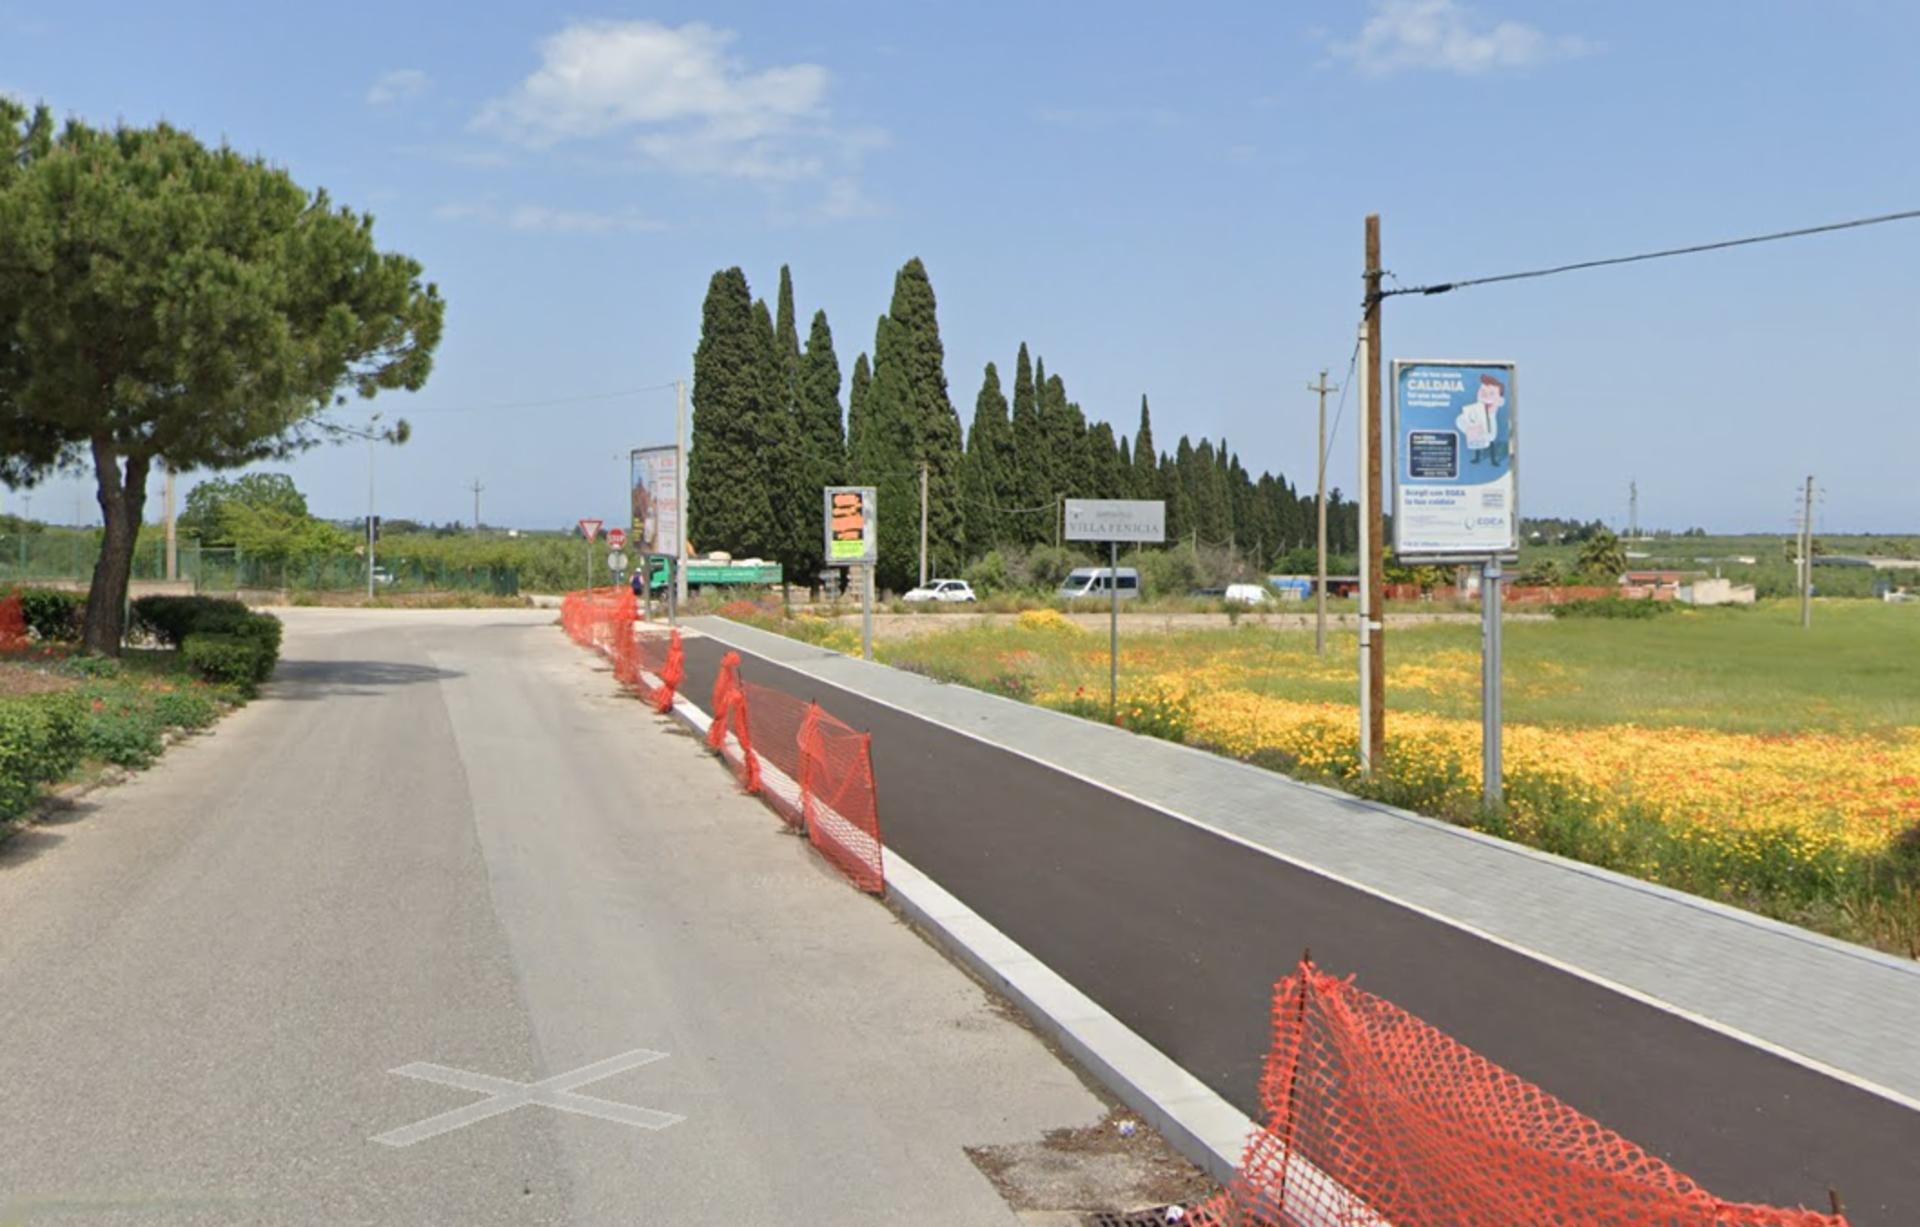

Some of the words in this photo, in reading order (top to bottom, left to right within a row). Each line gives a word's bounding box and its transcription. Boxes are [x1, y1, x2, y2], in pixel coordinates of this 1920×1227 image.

[1407, 379, 1465, 392] CALDAIA
[1069, 522, 1106, 533] VILLA
[1109, 522, 1159, 534] FENICIA
